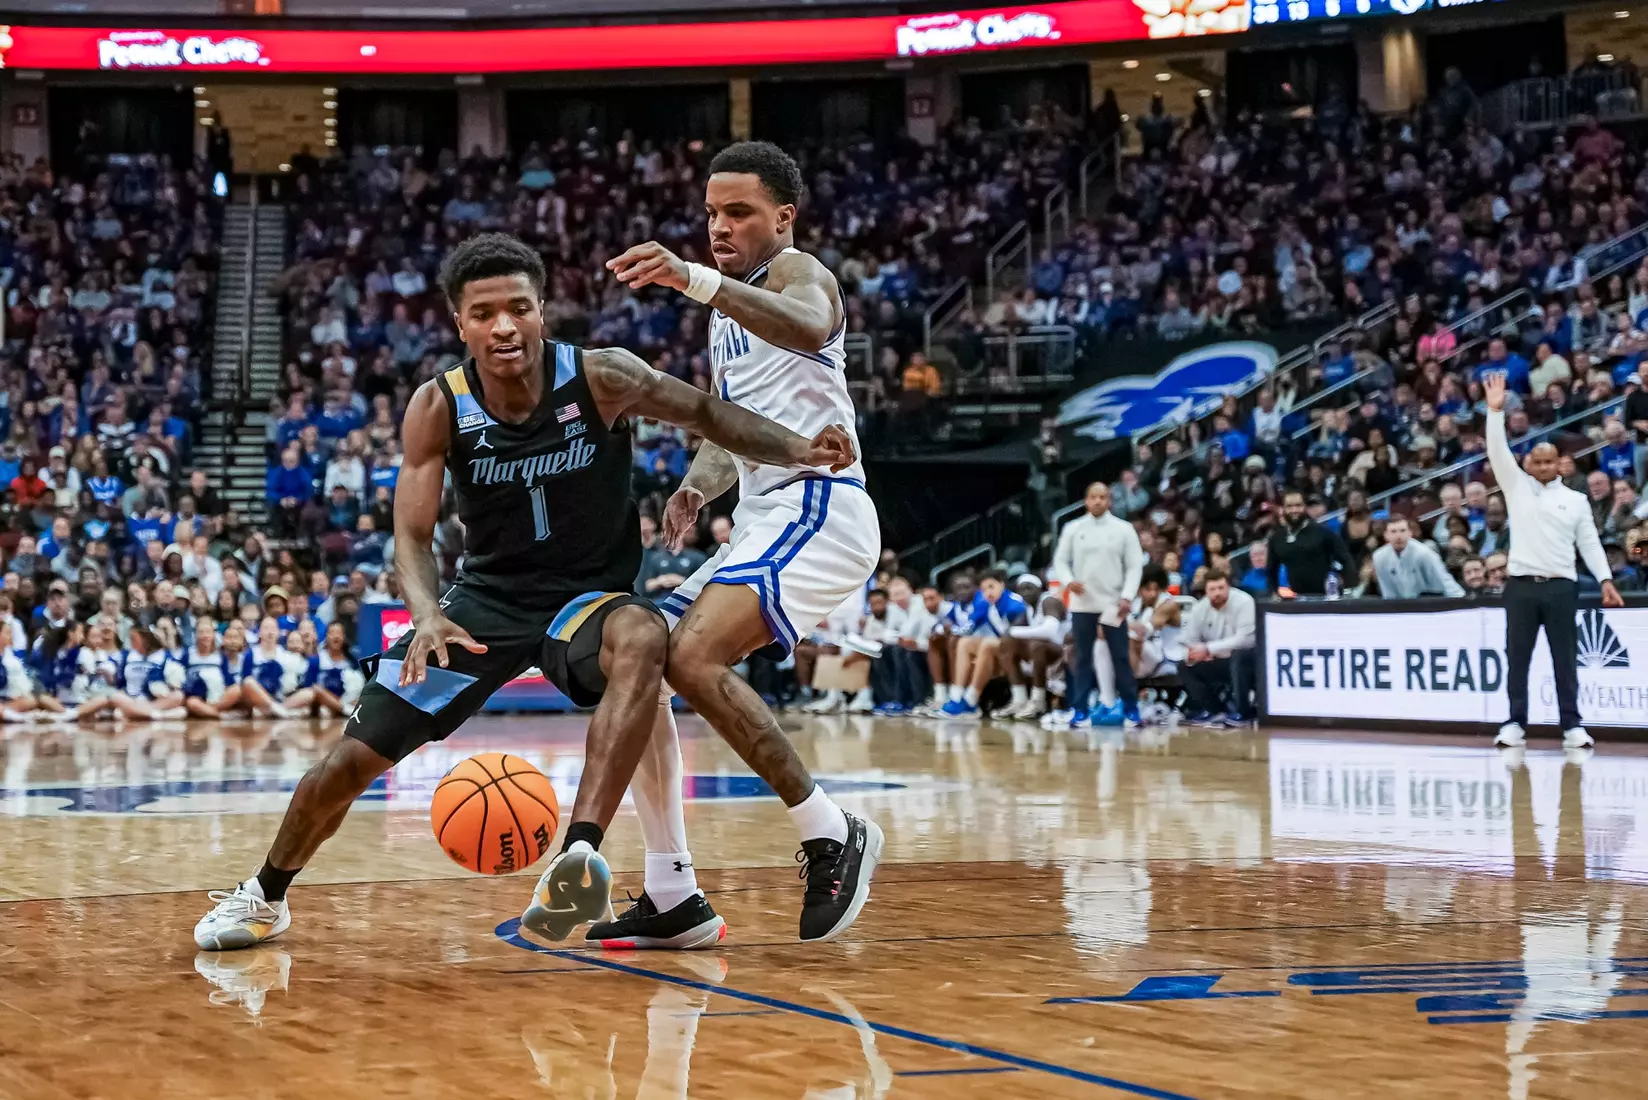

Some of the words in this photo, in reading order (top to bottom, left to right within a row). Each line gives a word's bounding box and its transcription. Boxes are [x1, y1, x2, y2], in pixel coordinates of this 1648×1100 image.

[468, 437, 596, 487] Marquette
[529, 485, 551, 540] 1
[1277, 648, 1392, 689] RETIRE
[1405, 648, 1501, 692] READ
